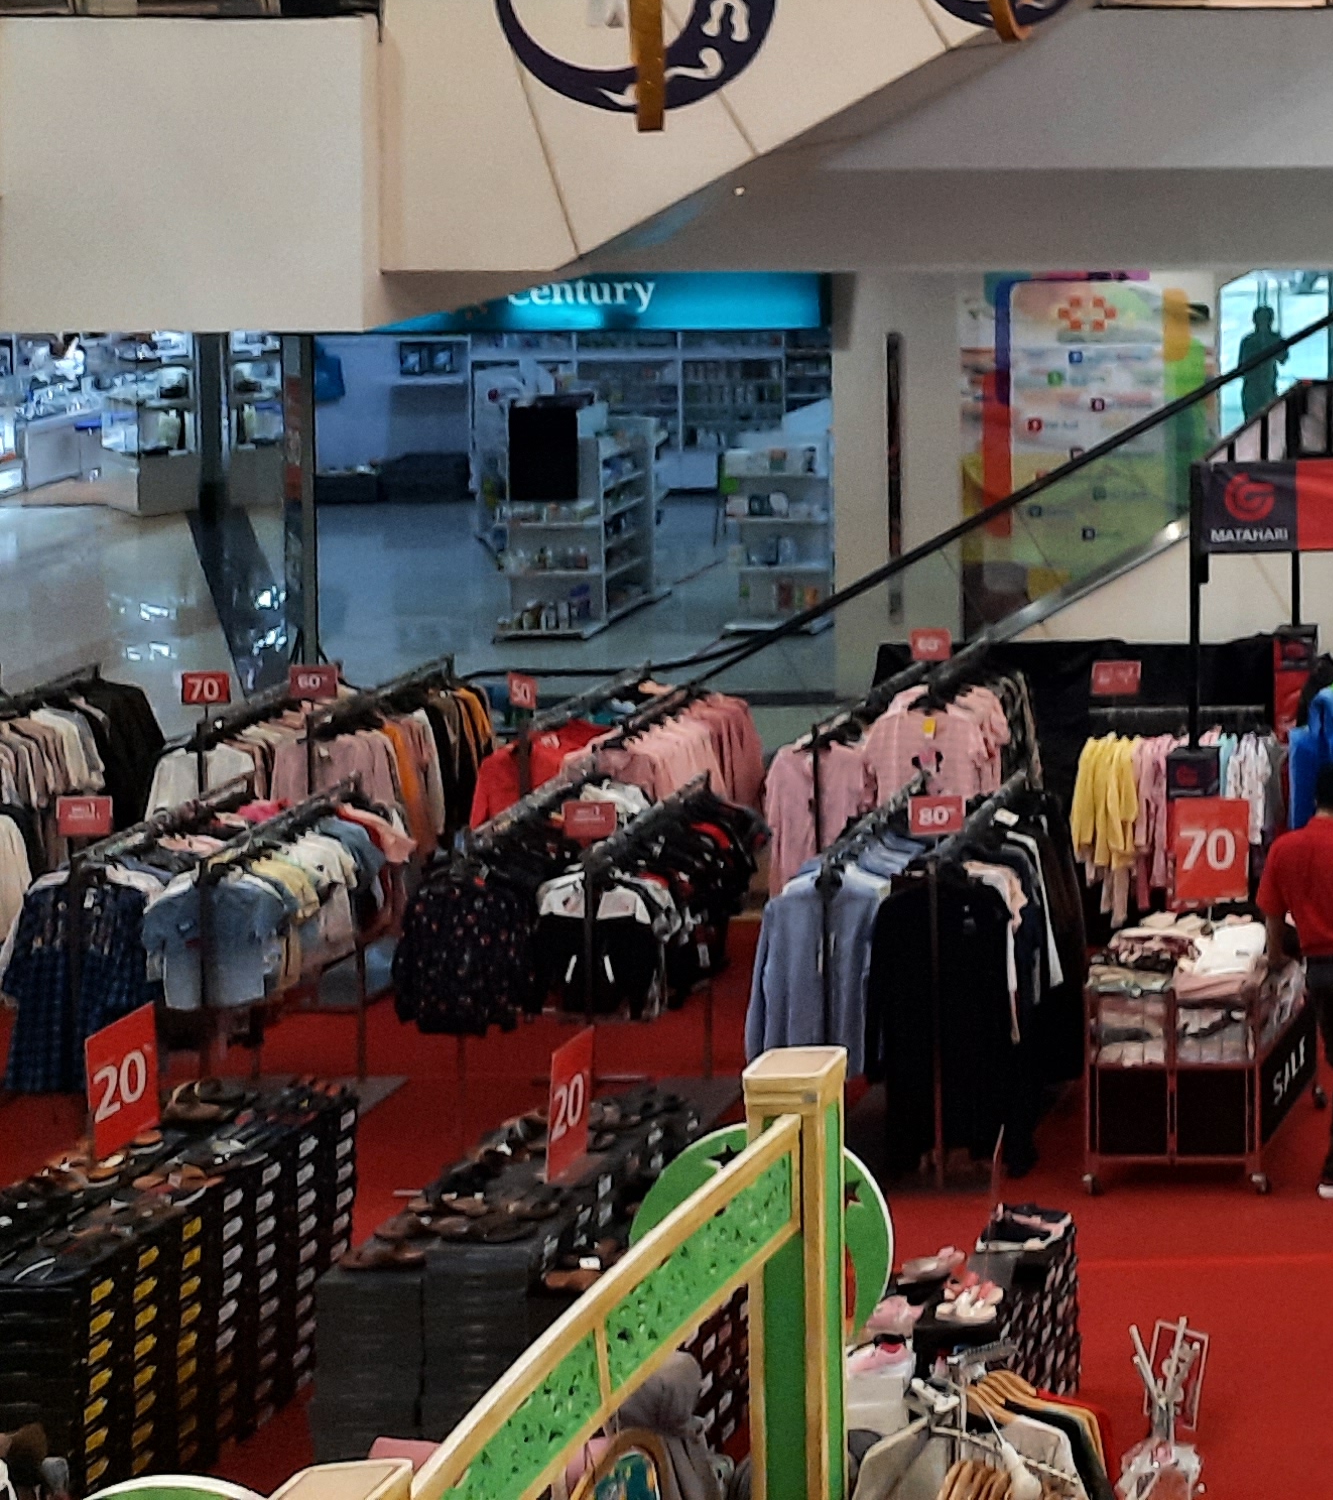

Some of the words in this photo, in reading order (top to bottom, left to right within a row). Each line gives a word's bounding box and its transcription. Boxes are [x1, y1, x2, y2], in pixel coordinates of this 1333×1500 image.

[1210, 527, 1289, 543] MATAHARI
[1179, 828, 1236, 870] 70
[1272, 1036, 1306, 1106] SALE
